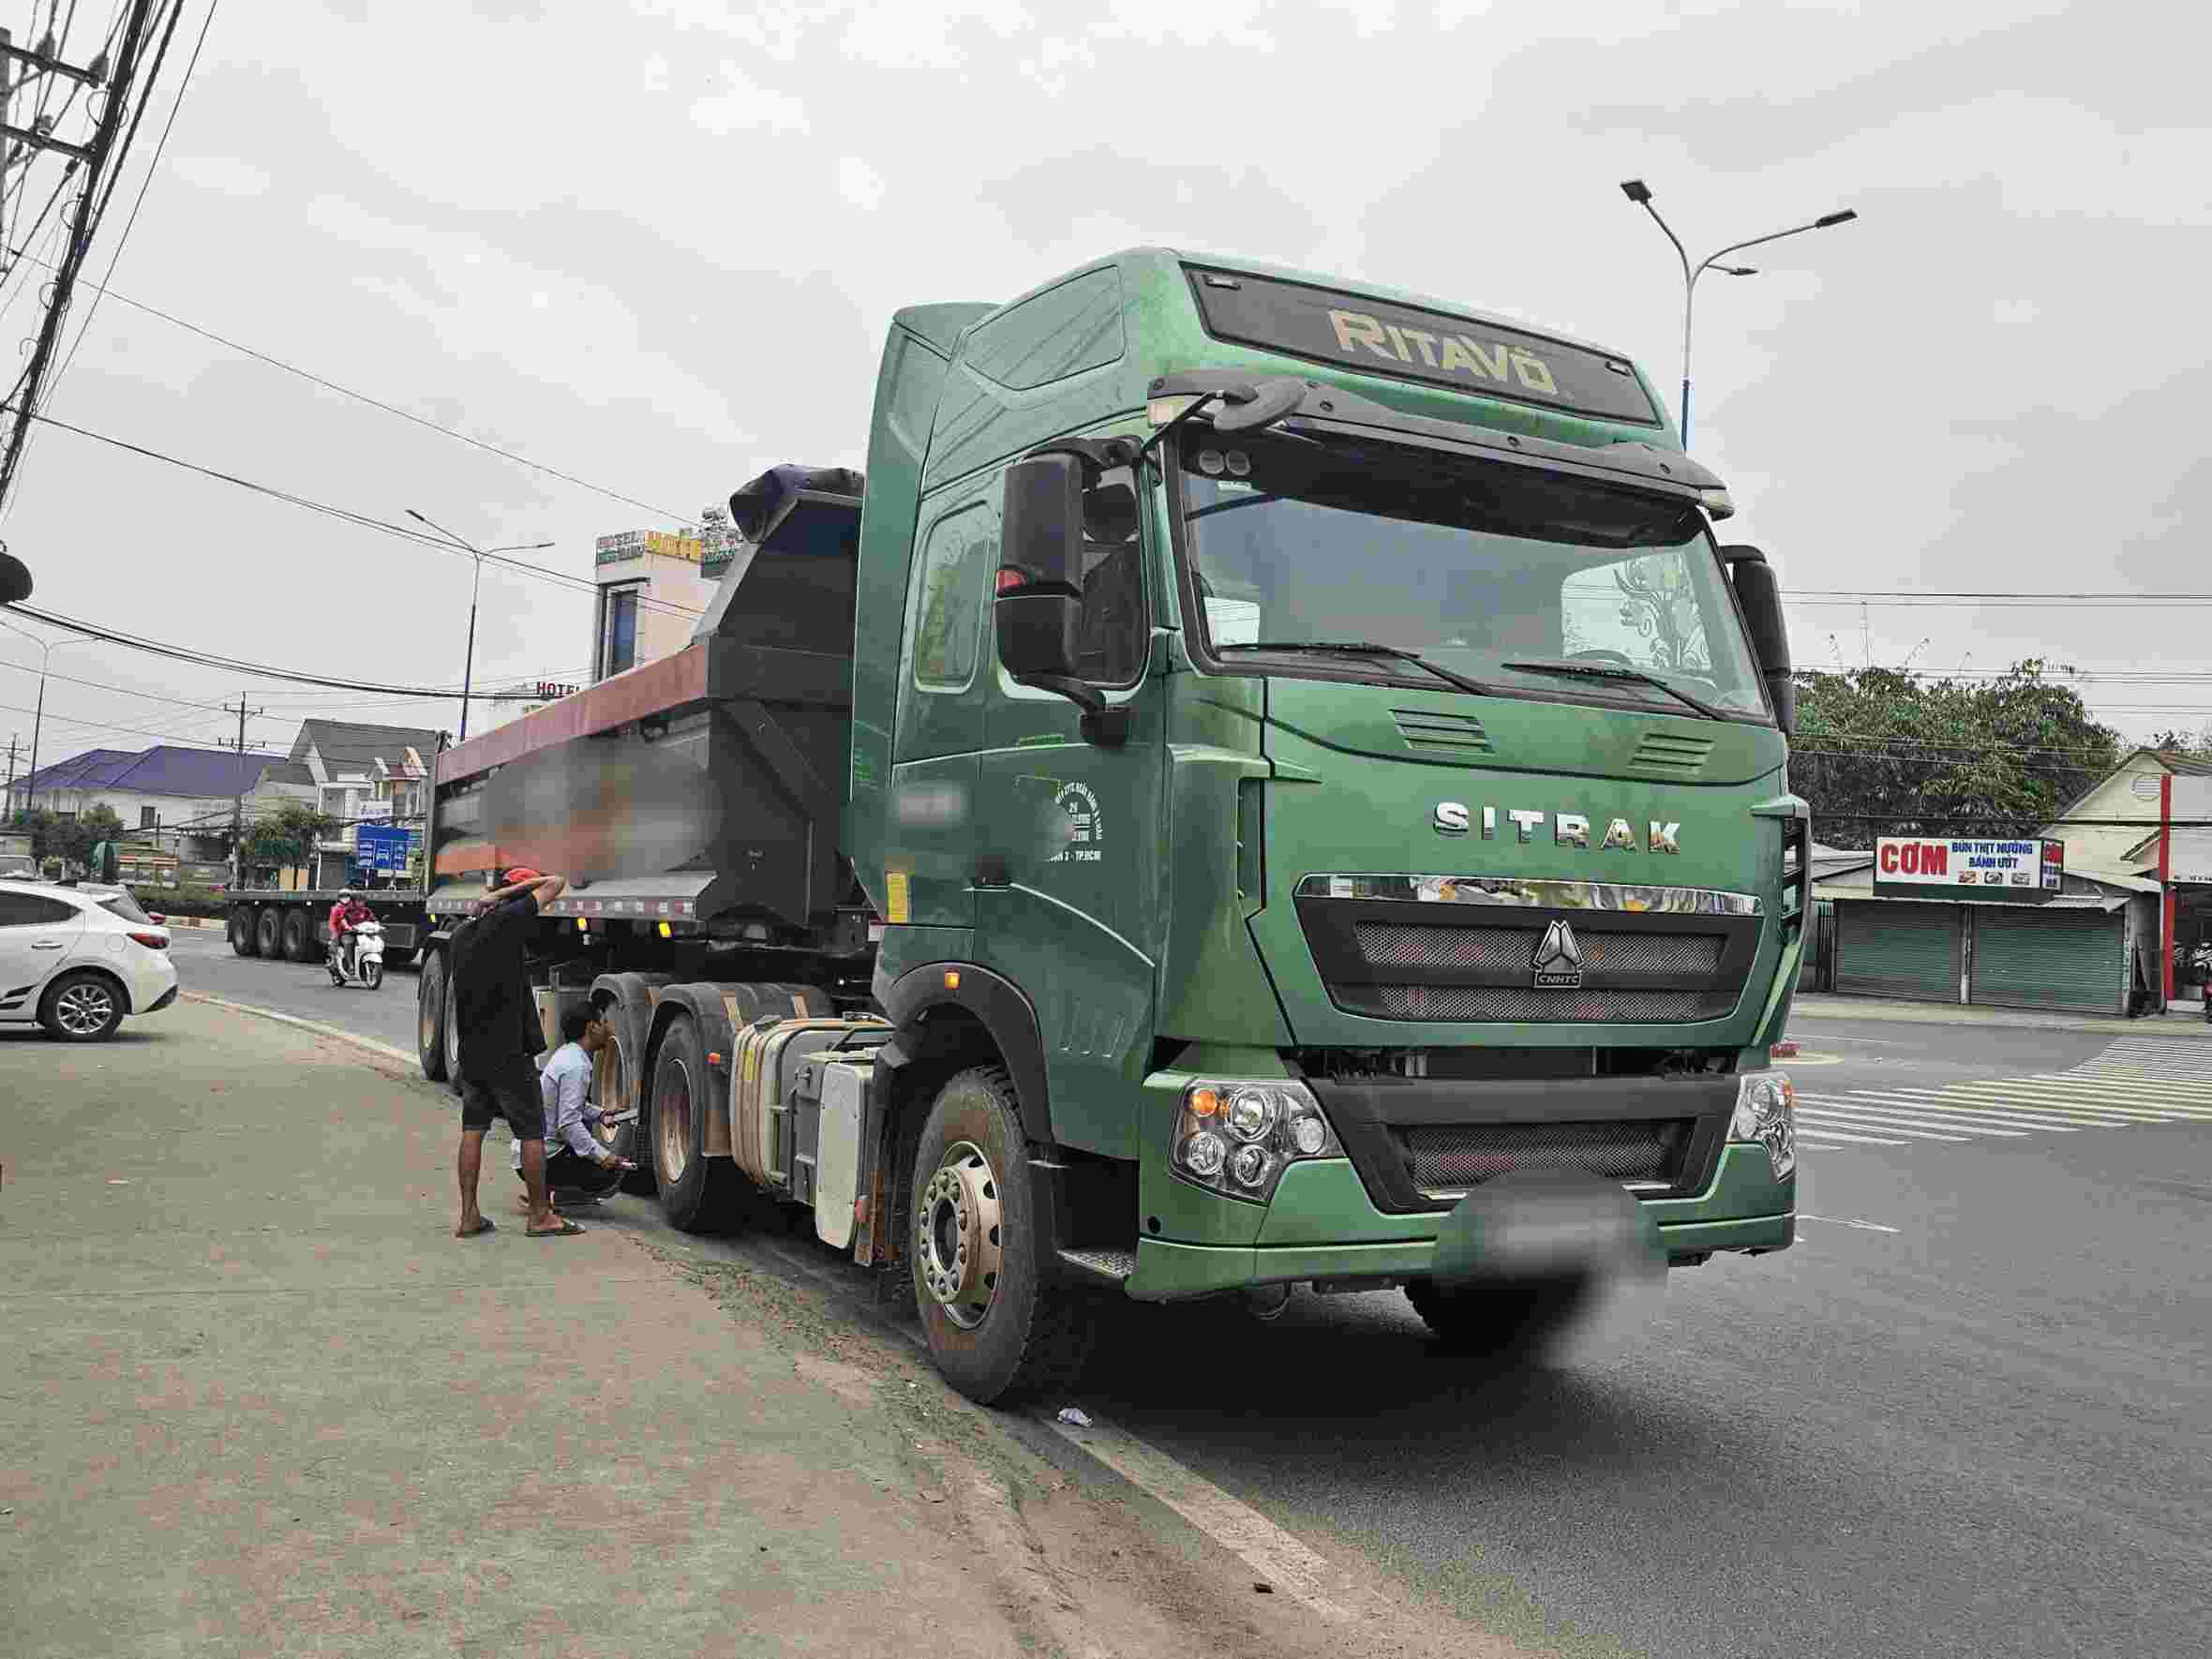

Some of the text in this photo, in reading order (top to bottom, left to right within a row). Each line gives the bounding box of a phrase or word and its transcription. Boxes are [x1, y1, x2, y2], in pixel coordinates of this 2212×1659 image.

[1433, 801, 1681, 855] SITRAK
[1880, 842, 1948, 876] CƠM
[1538, 974, 1579, 984] CNHTC
